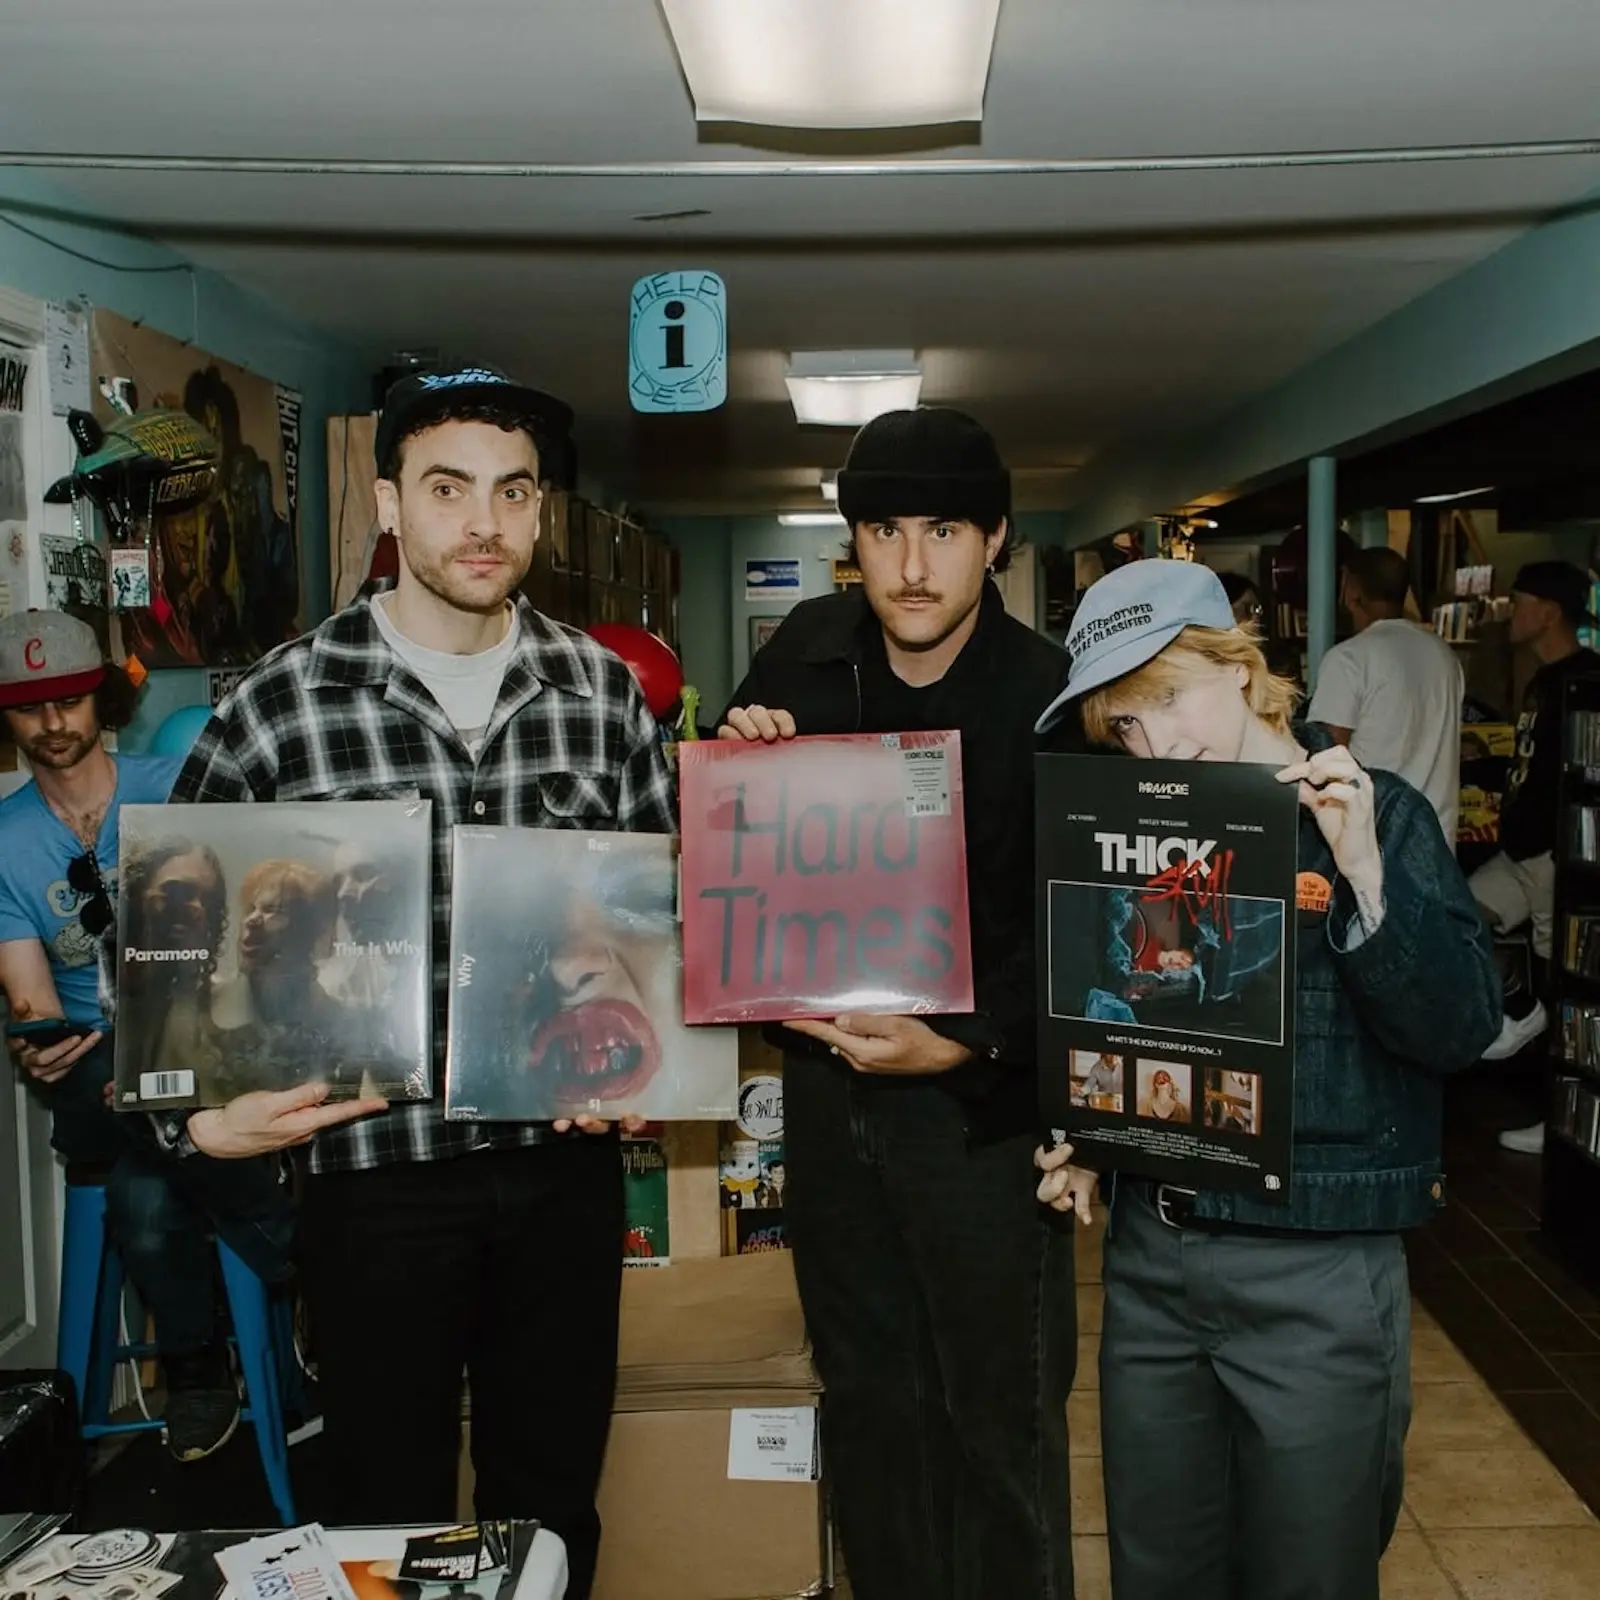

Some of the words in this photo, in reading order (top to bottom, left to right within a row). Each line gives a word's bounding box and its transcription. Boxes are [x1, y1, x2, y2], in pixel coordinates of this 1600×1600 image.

[633, 272, 720, 311] HELP
[632, 363, 722, 406] DESK
[1093, 615, 1152, 644] CLASSIFIED
[24, 638, 46, 670] C
[731, 779, 921, 880] Hard
[1094, 832, 1217, 878] THICK
[124, 947, 210, 963] Paramore
[333, 941, 365, 957] This
[699, 886, 956, 988] Times
[458, 953, 476, 988] Why
